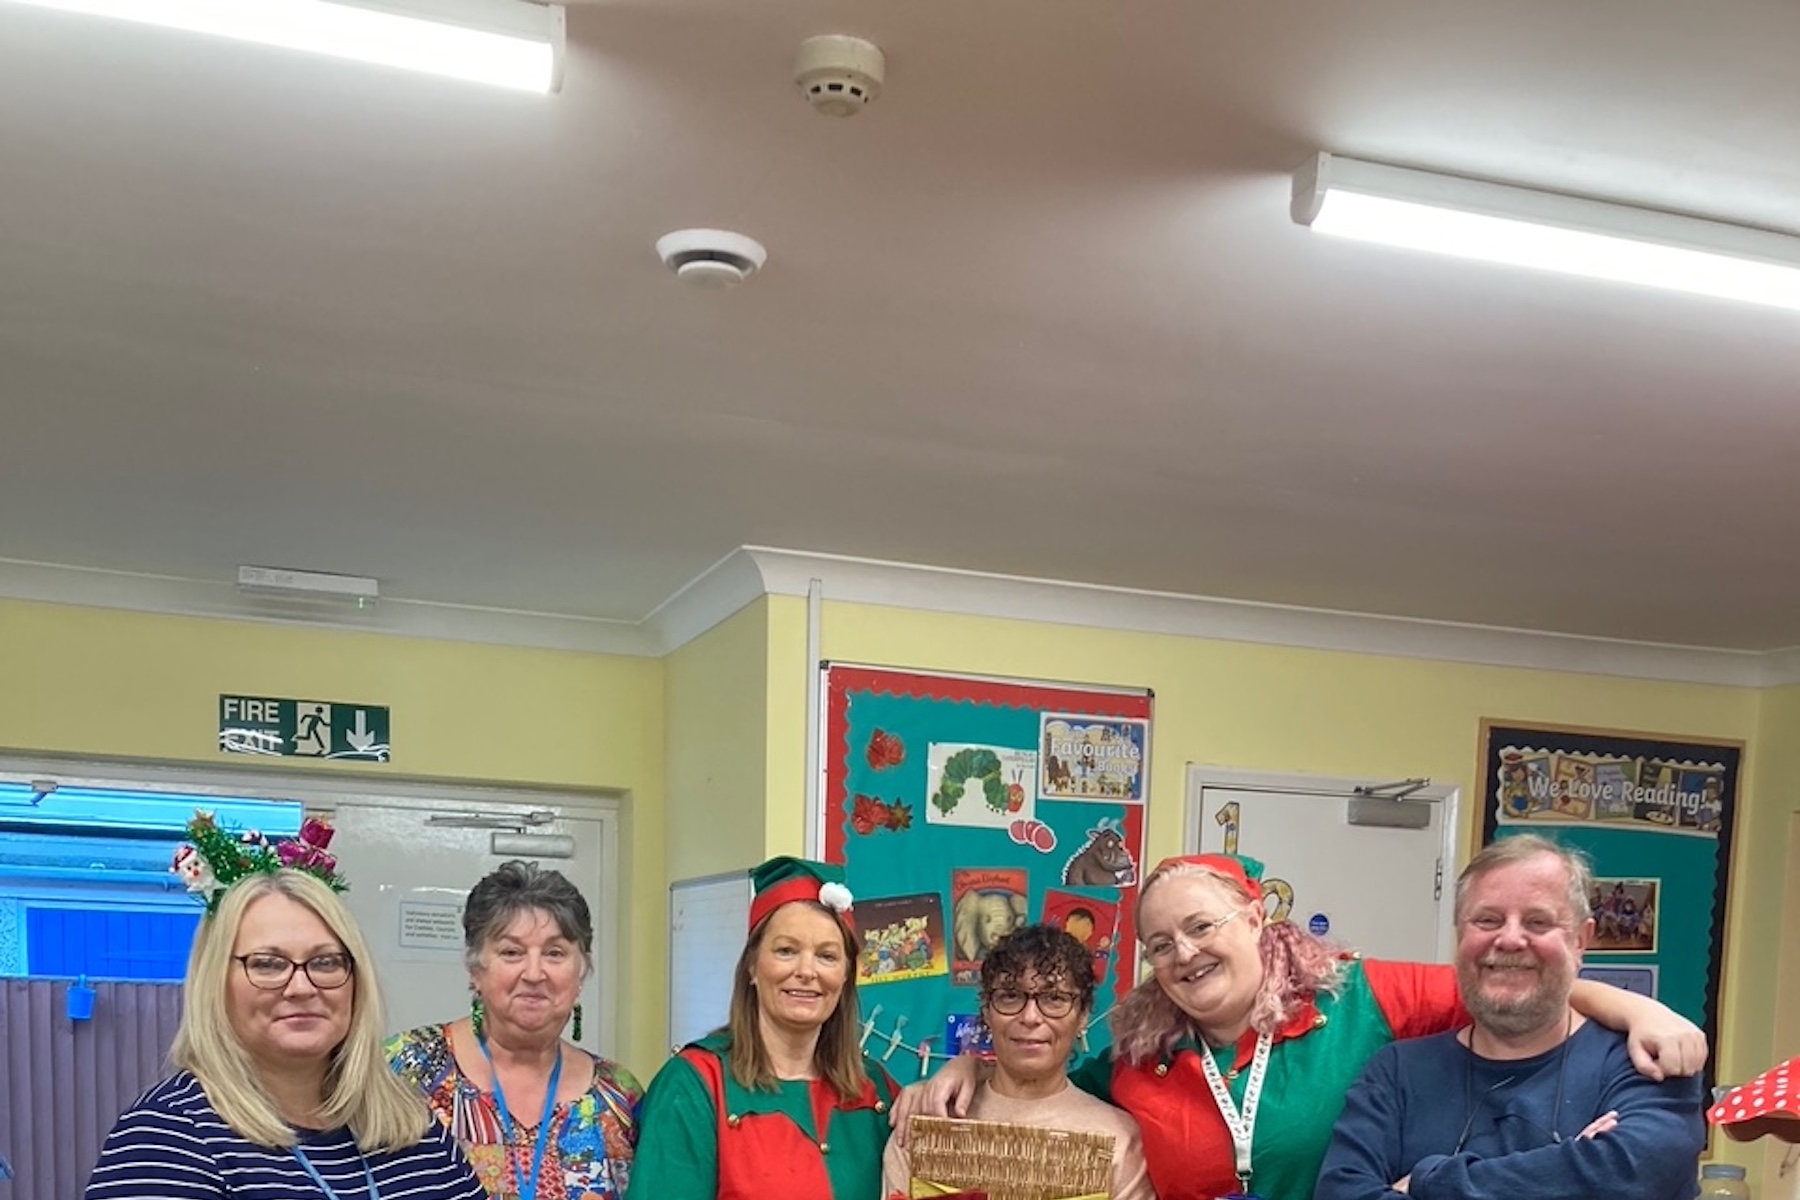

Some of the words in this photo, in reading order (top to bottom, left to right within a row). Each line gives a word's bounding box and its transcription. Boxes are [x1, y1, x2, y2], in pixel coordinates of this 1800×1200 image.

[223, 698, 280, 723] FIRE
[1528, 776, 1563, 799] We
[1567, 781, 1613, 800] Love
[1621, 781, 1708, 815] Reading!
